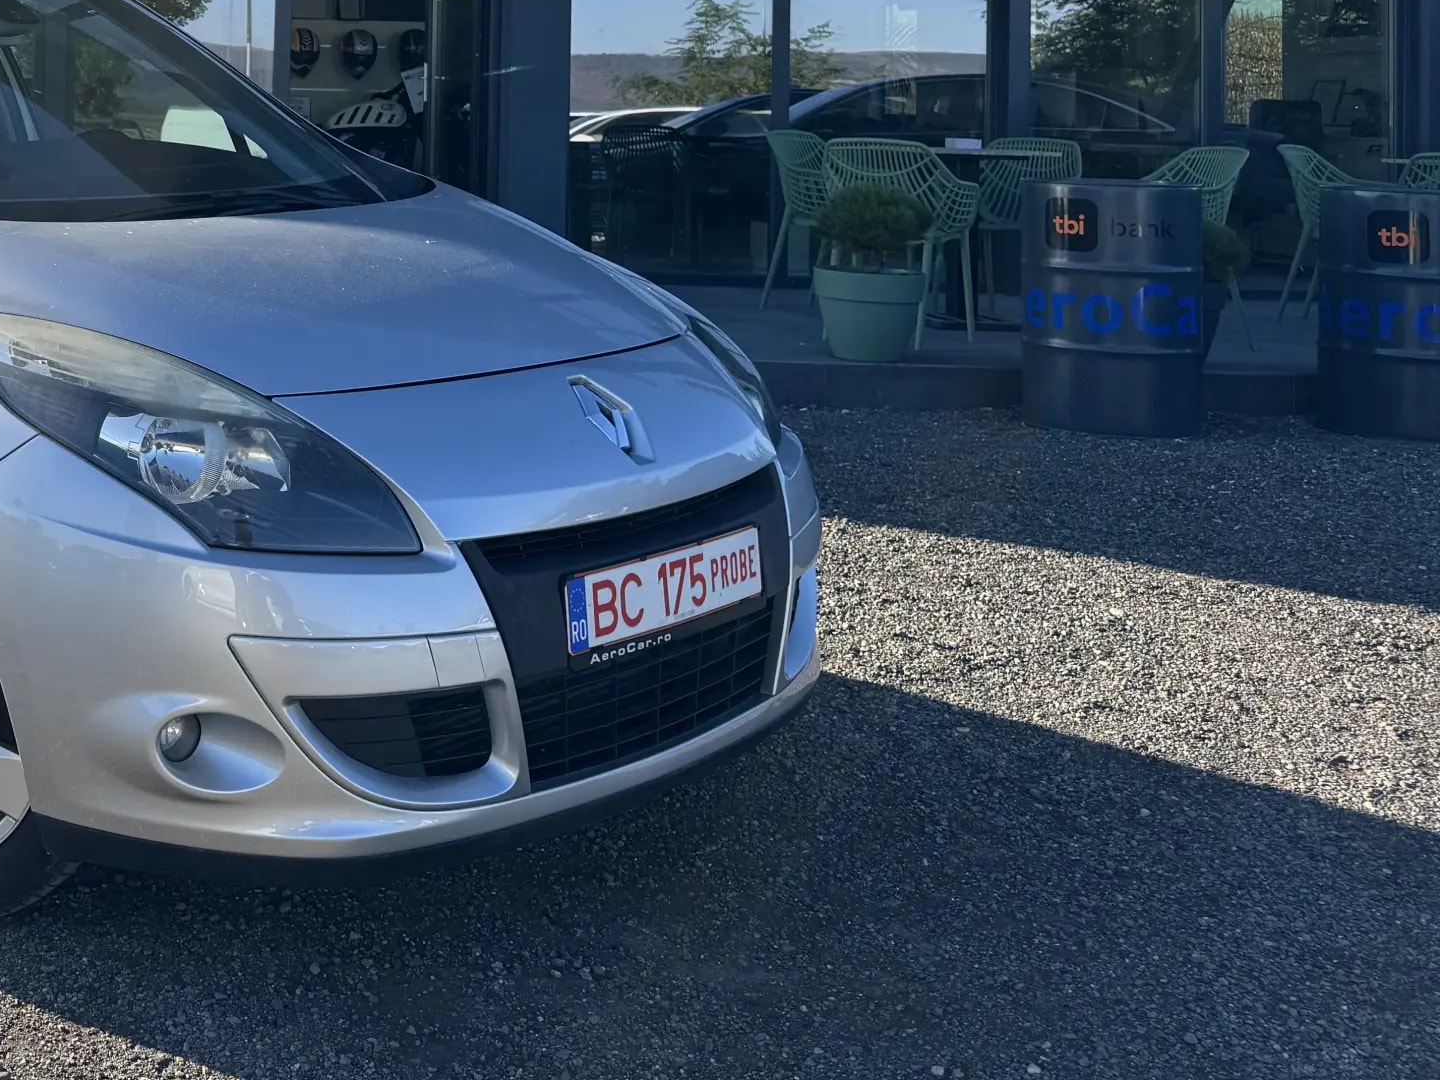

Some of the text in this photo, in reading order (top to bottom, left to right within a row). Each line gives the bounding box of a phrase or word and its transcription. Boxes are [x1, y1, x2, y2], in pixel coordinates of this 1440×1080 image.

[1053, 214, 1174, 239] tbi bank
[1377, 226, 1416, 248] tbi
[592, 544, 757, 638] BC 175 PROBE
[571, 619, 587, 644] RO
[589, 633, 672, 665] AeroCar.ro
